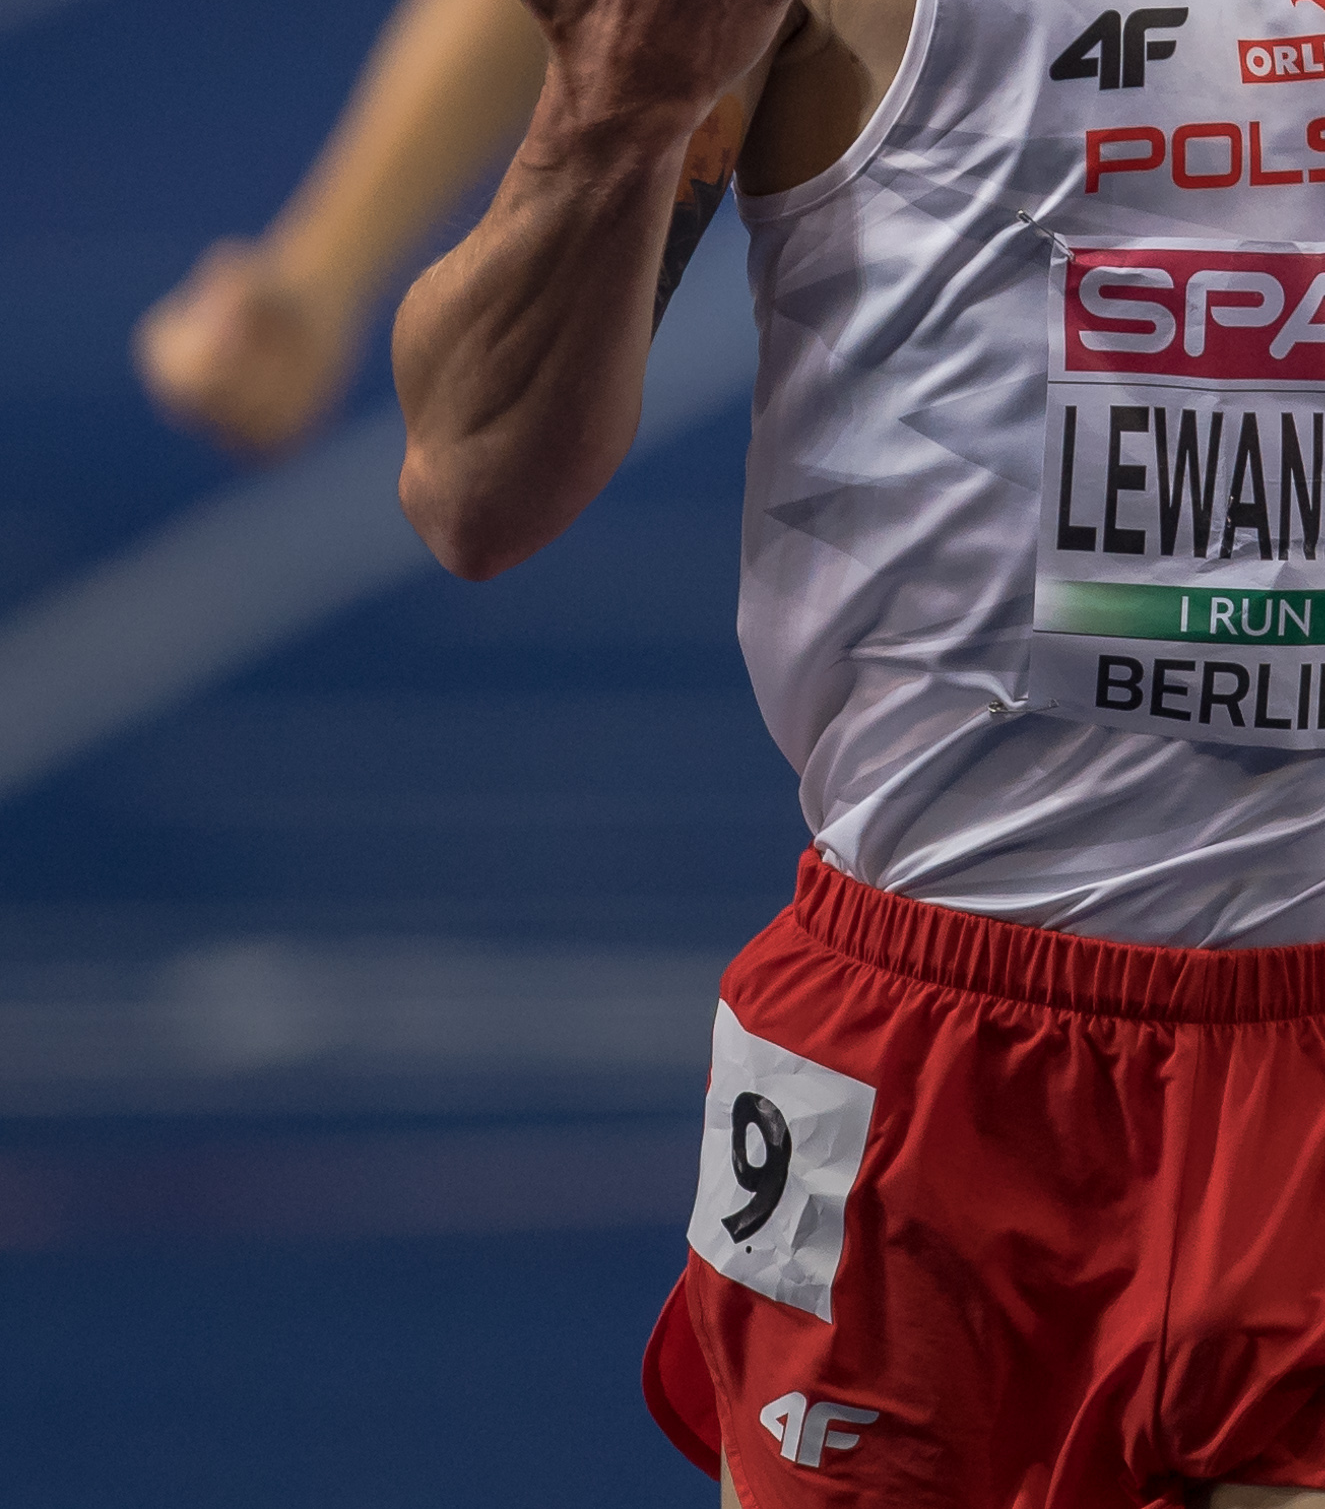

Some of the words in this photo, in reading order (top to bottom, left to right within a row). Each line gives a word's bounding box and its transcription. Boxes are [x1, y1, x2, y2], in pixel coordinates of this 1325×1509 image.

[1048, 6, 1189, 91] 4F
[1180, 595, 1190, 633] I
[1210, 596, 1312, 638] RUN
[759, 1390, 880, 1469] 4F
